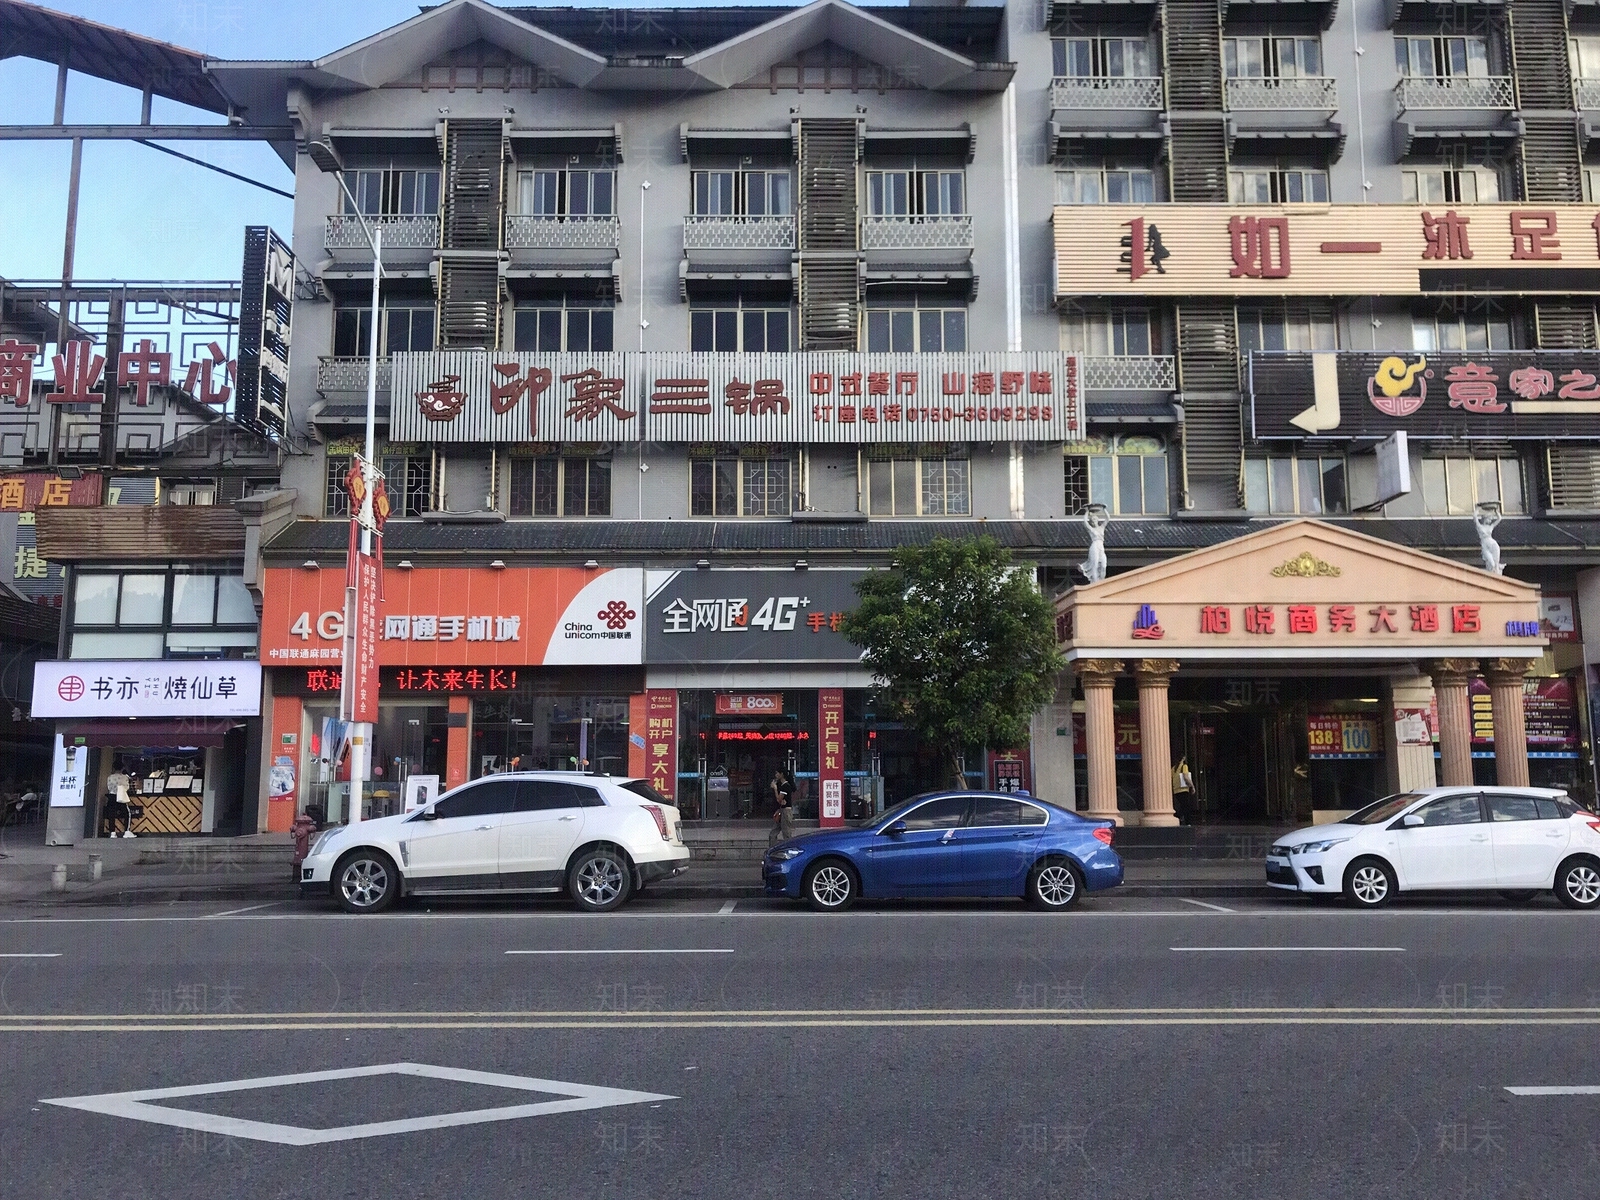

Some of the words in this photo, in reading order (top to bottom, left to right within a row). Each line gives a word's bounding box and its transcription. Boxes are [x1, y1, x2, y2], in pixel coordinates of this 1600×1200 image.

[1228, 209, 1600, 279] 如一沐足
[810, 371, 919, 395] 中式餐厅
[942, 371, 1053, 395] 山海野味
[0, 478, 73, 509] 酒店
[564, 622, 593, 631] China
[663, 597, 749, 633] 全网通
[1200, 604, 1482, 634] 柏悦商务大酒店
[379, 614, 521, 642] 网通手机城
[564, 631, 600, 640] unicom
[90, 676, 140, 700] 书亦
[649, 718, 673, 728] 购机
[649, 729, 673, 739] 开户
[1118, 723, 1140, 745] 元
[825, 711, 839, 769] 开户有礼
[1308, 730, 1333, 745] 138
[1343, 728, 1371, 749] 100
[652, 743, 669, 791] 享大礼
[60, 776, 77, 784] 半杯
